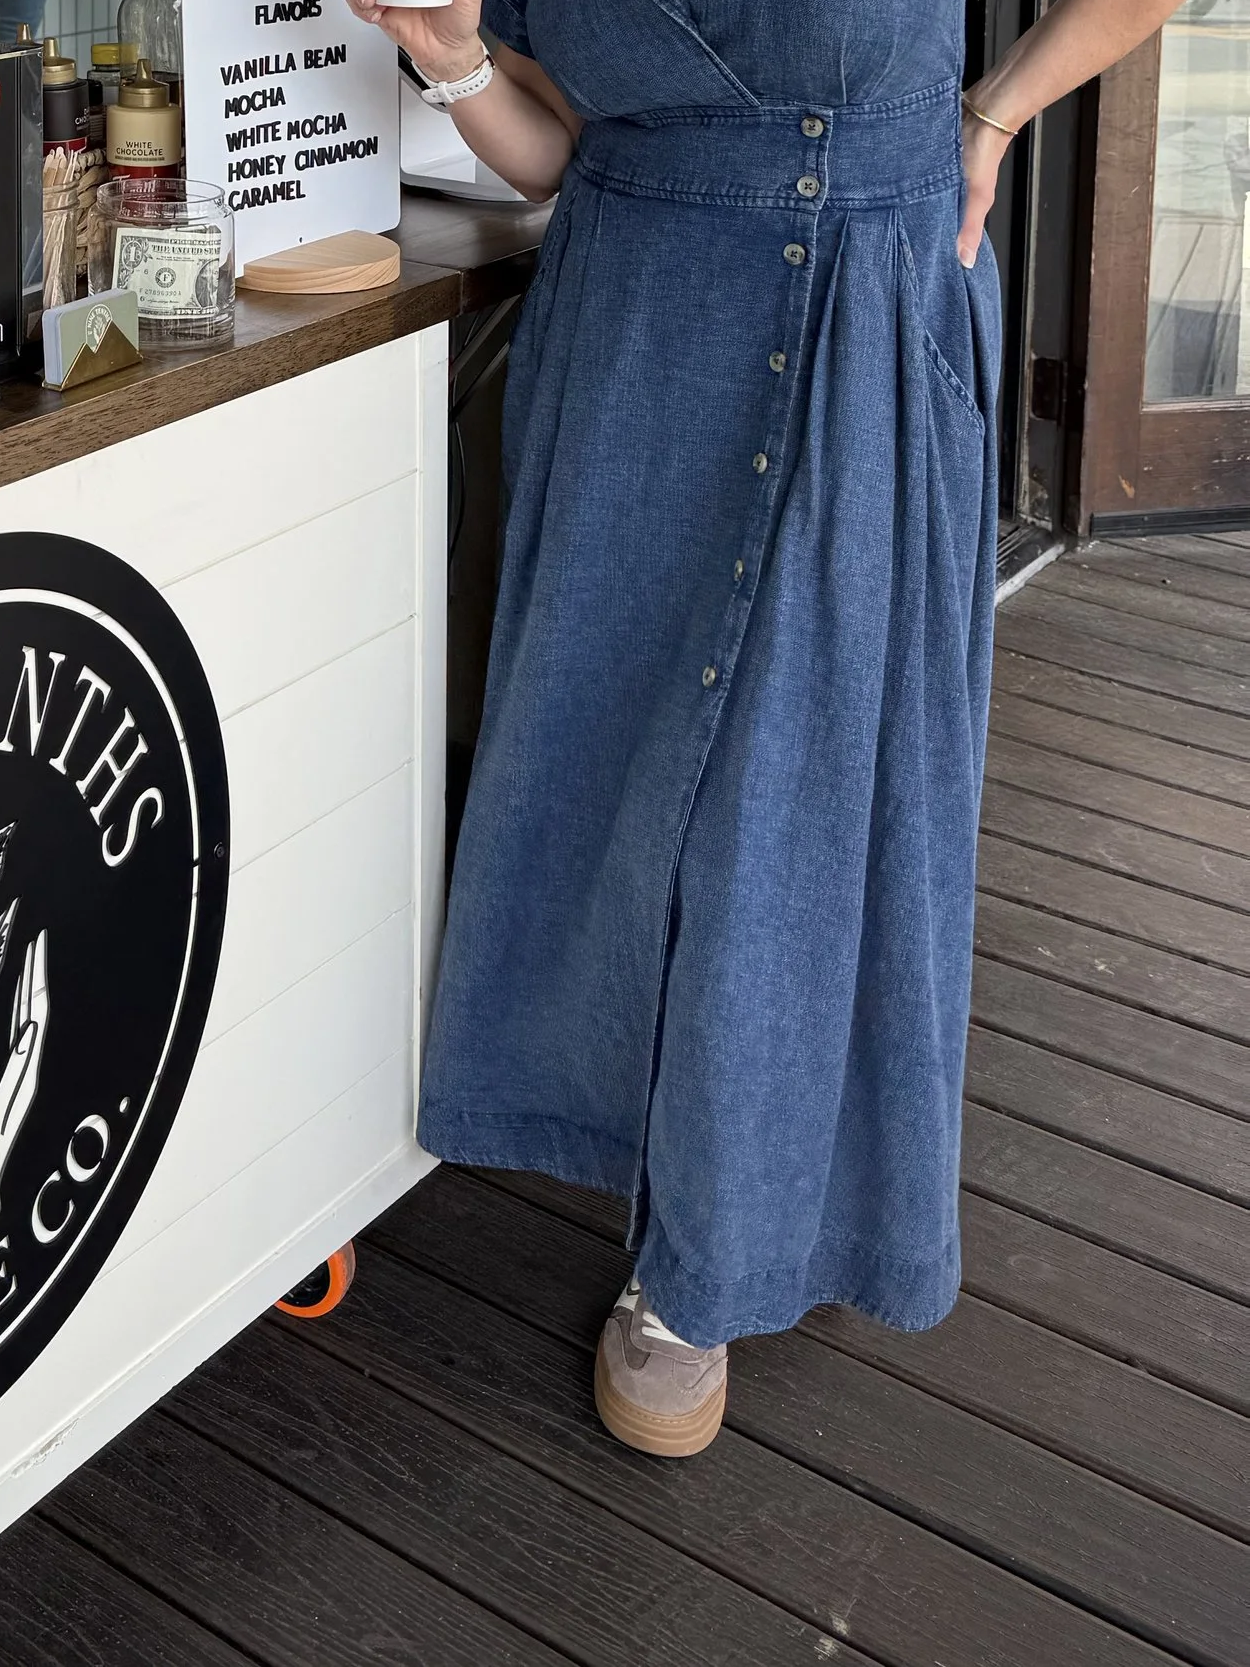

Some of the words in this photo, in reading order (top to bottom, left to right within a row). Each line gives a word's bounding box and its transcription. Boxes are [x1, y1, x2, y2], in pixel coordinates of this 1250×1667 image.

[220, 52, 297, 86] VANILLA
[303, 44, 347, 69] BEAN
[224, 86, 287, 119] MOCHA
[126, 140, 152, 149] WHITE
[225, 120, 282, 152] WHITE
[286, 113, 347, 141] MOCHA
[116, 147, 163, 157] CHOCOLATE
[228, 154, 286, 182] HONEY
[294, 136, 378, 172] CINNAMON
[228, 180, 306, 212] CARAMEL
[152, 244, 170, 254] THE
[171, 245, 203, 256] UNITED
[32, 1096, 131, 1244] CO.
